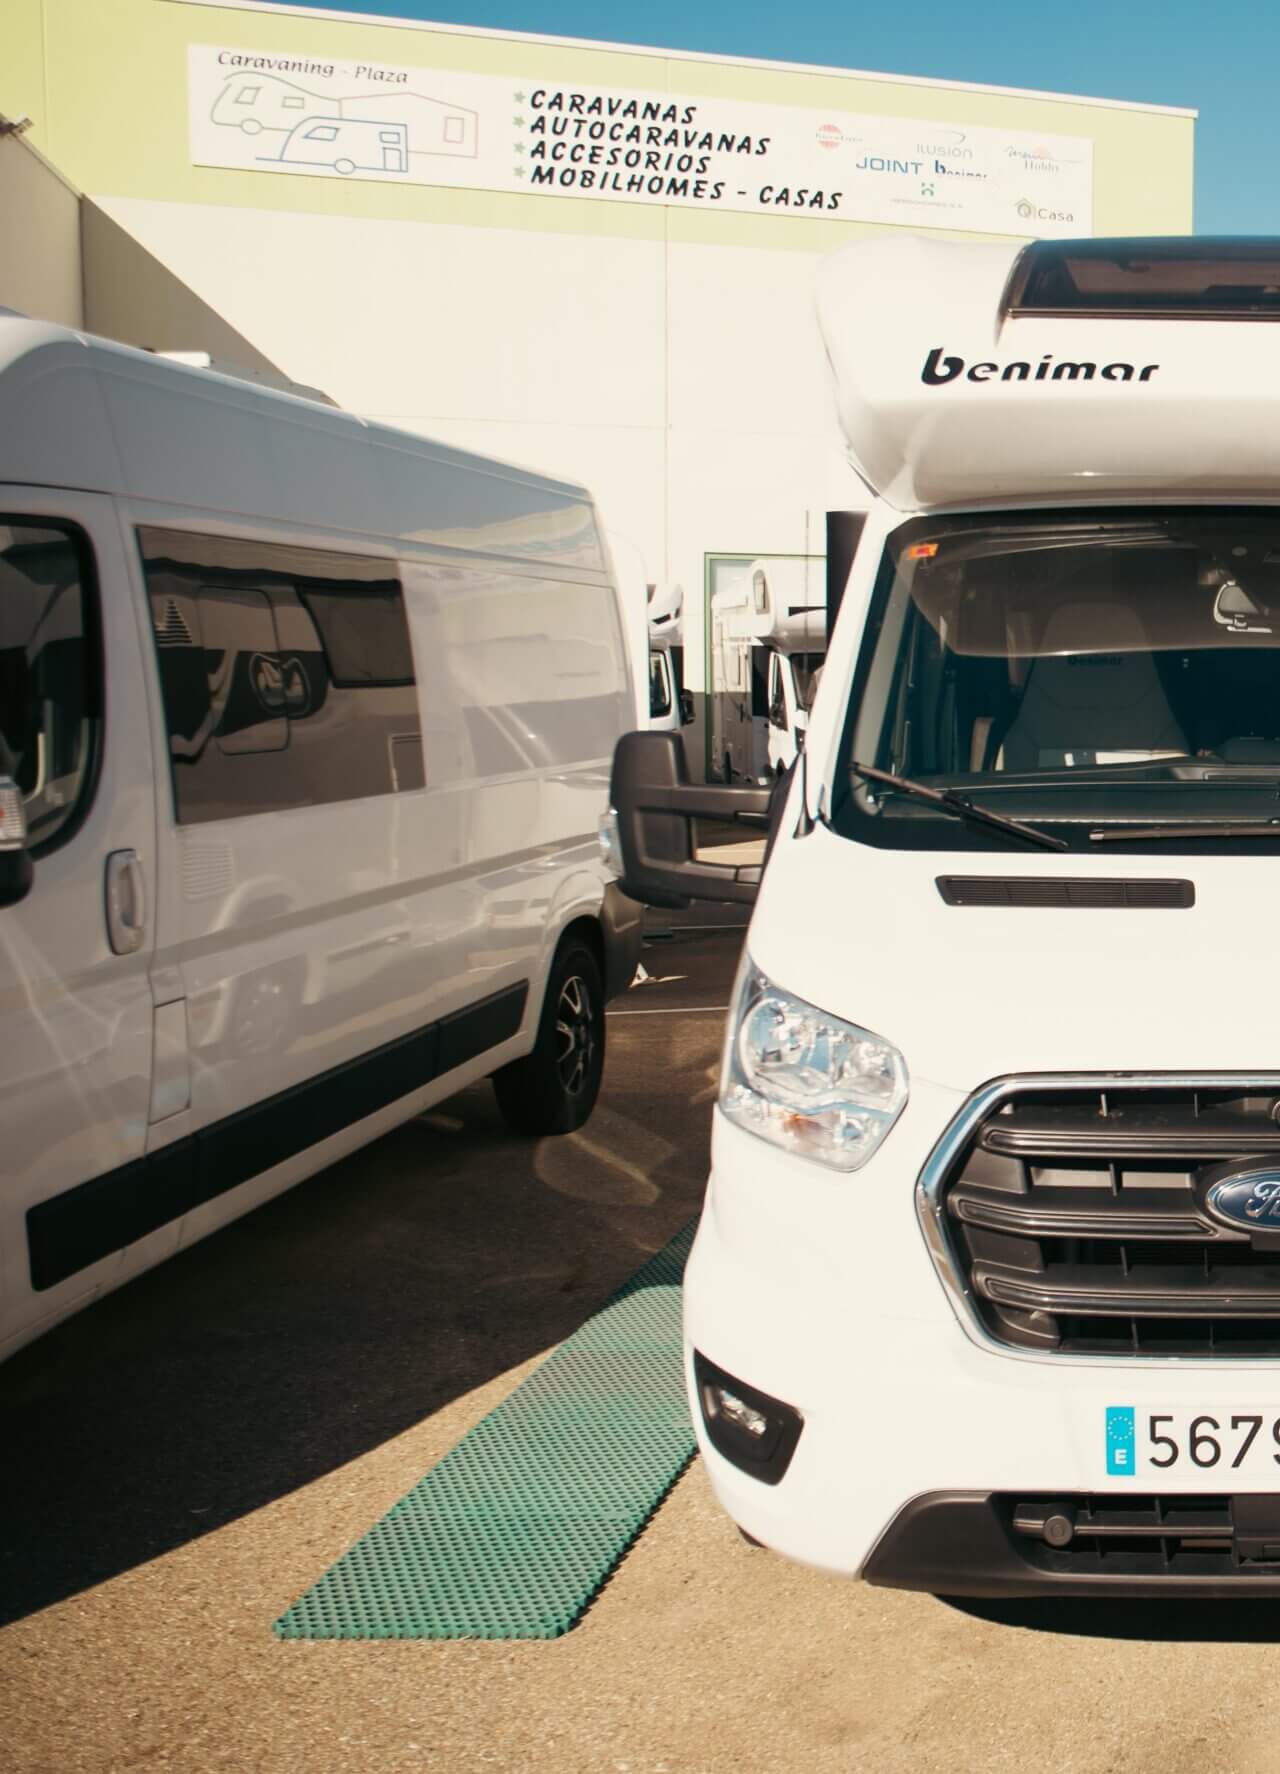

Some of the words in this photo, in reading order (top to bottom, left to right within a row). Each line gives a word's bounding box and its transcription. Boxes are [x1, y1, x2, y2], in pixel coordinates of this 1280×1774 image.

[217, 50, 335, 78] Caravaning
[354, 64, 408, 84] Plaza
[530, 90, 696, 124] CARAVANAS
[530, 115, 771, 155] AUTOCARAVANAS
[530, 140, 711, 174] ACCESORIOS
[855, 157, 923, 175] JOINT
[530, 165, 726, 200] MOBILHOMES
[759, 185, 843, 210] CASAS
[1038, 207, 1074, 223] Casa
[920, 347, 1160, 386] benimar
[1114, 1449, 1127, 1464] E
